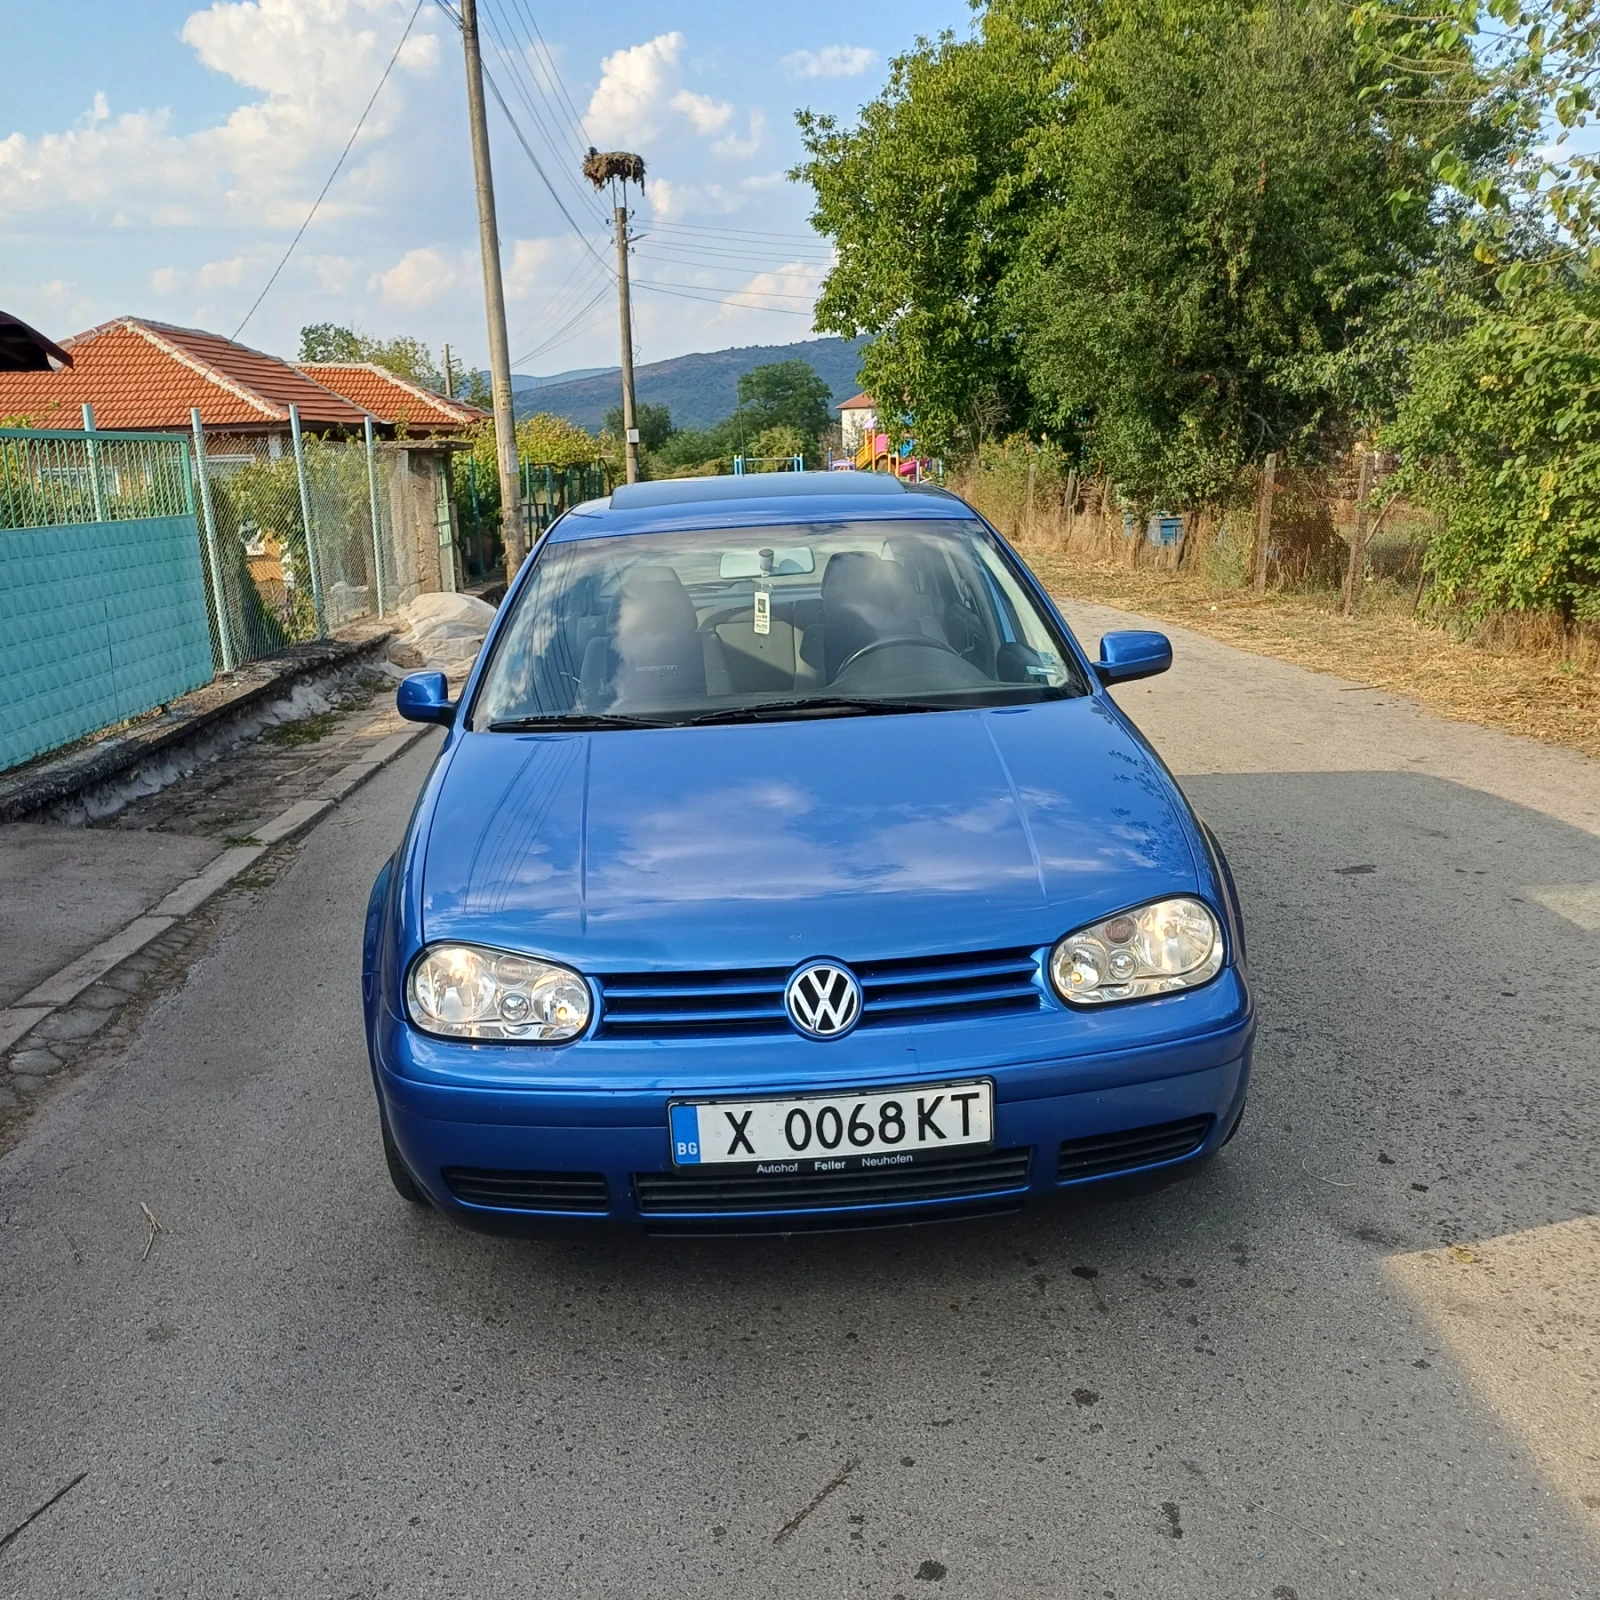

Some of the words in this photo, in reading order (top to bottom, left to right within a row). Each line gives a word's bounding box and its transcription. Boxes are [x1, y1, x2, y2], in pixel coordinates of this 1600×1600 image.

[789, 965, 857, 1034] VW
[724, 1110, 756, 1155] X
[784, 1101, 906, 1152] 0068
[676, 1142, 698, 1156] BG
[756, 1162, 799, 1174] Autohof
[862, 1154, 913, 1168] Neuhofen
